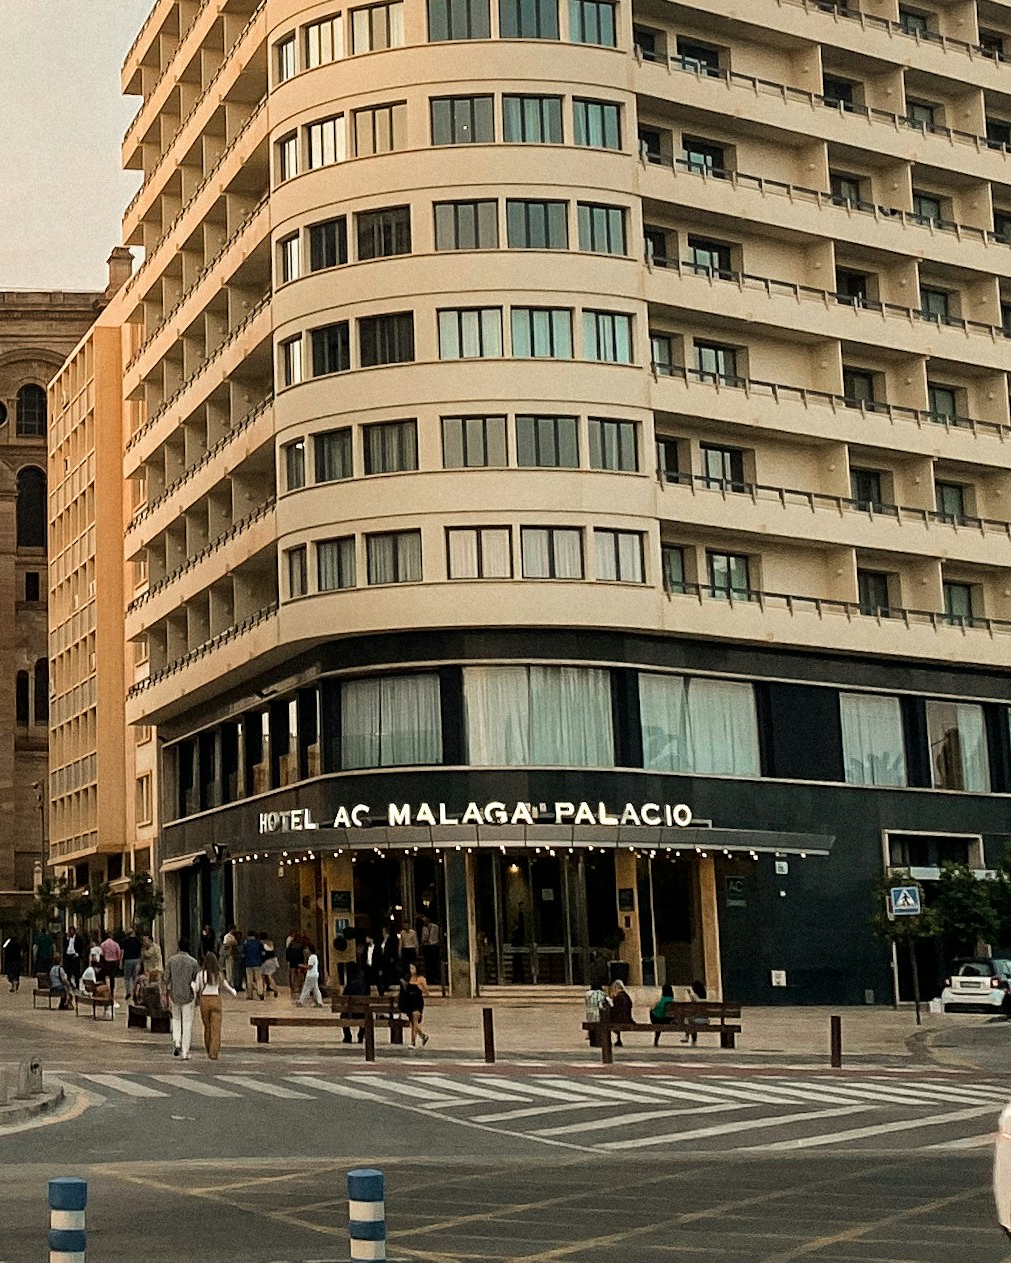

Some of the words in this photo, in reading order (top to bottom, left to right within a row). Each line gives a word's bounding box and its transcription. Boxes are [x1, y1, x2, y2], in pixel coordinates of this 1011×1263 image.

[259, 808, 318, 835] HOTEL
[333, 803, 371, 828] AC
[388, 801, 534, 827] MALAGA
[555, 801, 693, 828] PALACIO
